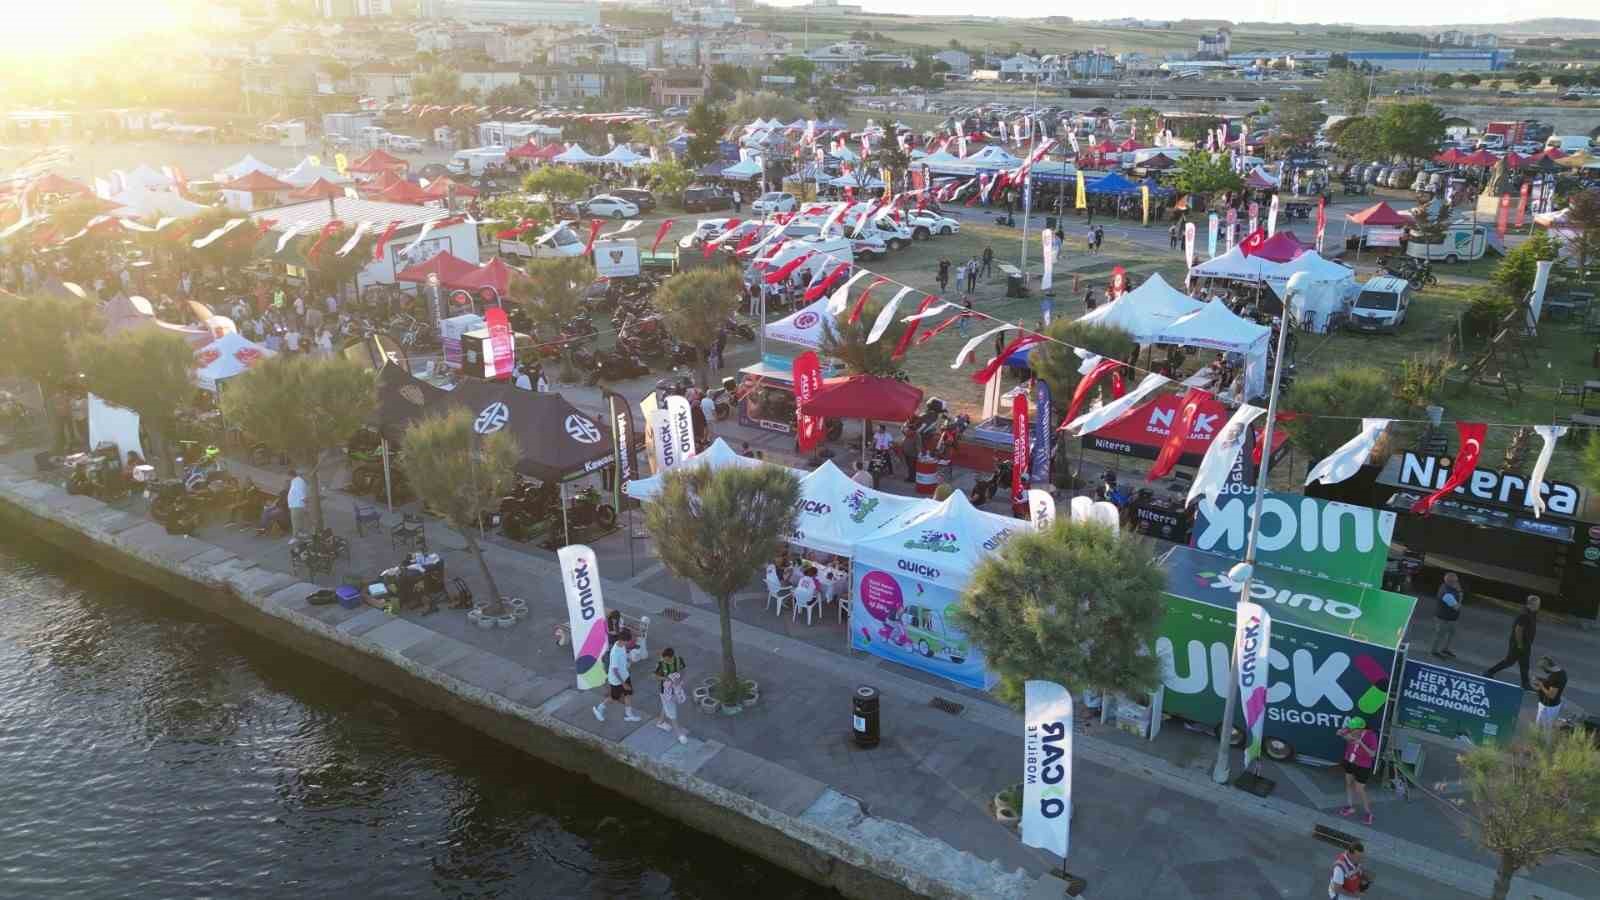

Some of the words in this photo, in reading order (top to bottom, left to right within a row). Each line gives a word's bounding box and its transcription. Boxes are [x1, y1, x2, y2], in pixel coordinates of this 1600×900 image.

[1146, 425, 1170, 435] SPAR
[1150, 406, 1219, 433] NK
[1095, 439, 1131, 453] Niterra
[1401, 452, 1577, 515] Nierra
[795, 498, 826, 515] ICK
[1138, 507, 1177, 526] Niterra
[1404, 491, 1509, 518] Nerra
[1197, 497, 1391, 553] UICK
[897, 559, 936, 577] QUICK
[1210, 574, 1362, 619] QUICK
[1156, 636, 1354, 712] UIK
[1418, 670, 1447, 686] HER
[1451, 679, 1486, 697] YAŞA
[1410, 679, 1438, 695] HER
[1440, 688, 1490, 709] ARAÇA
